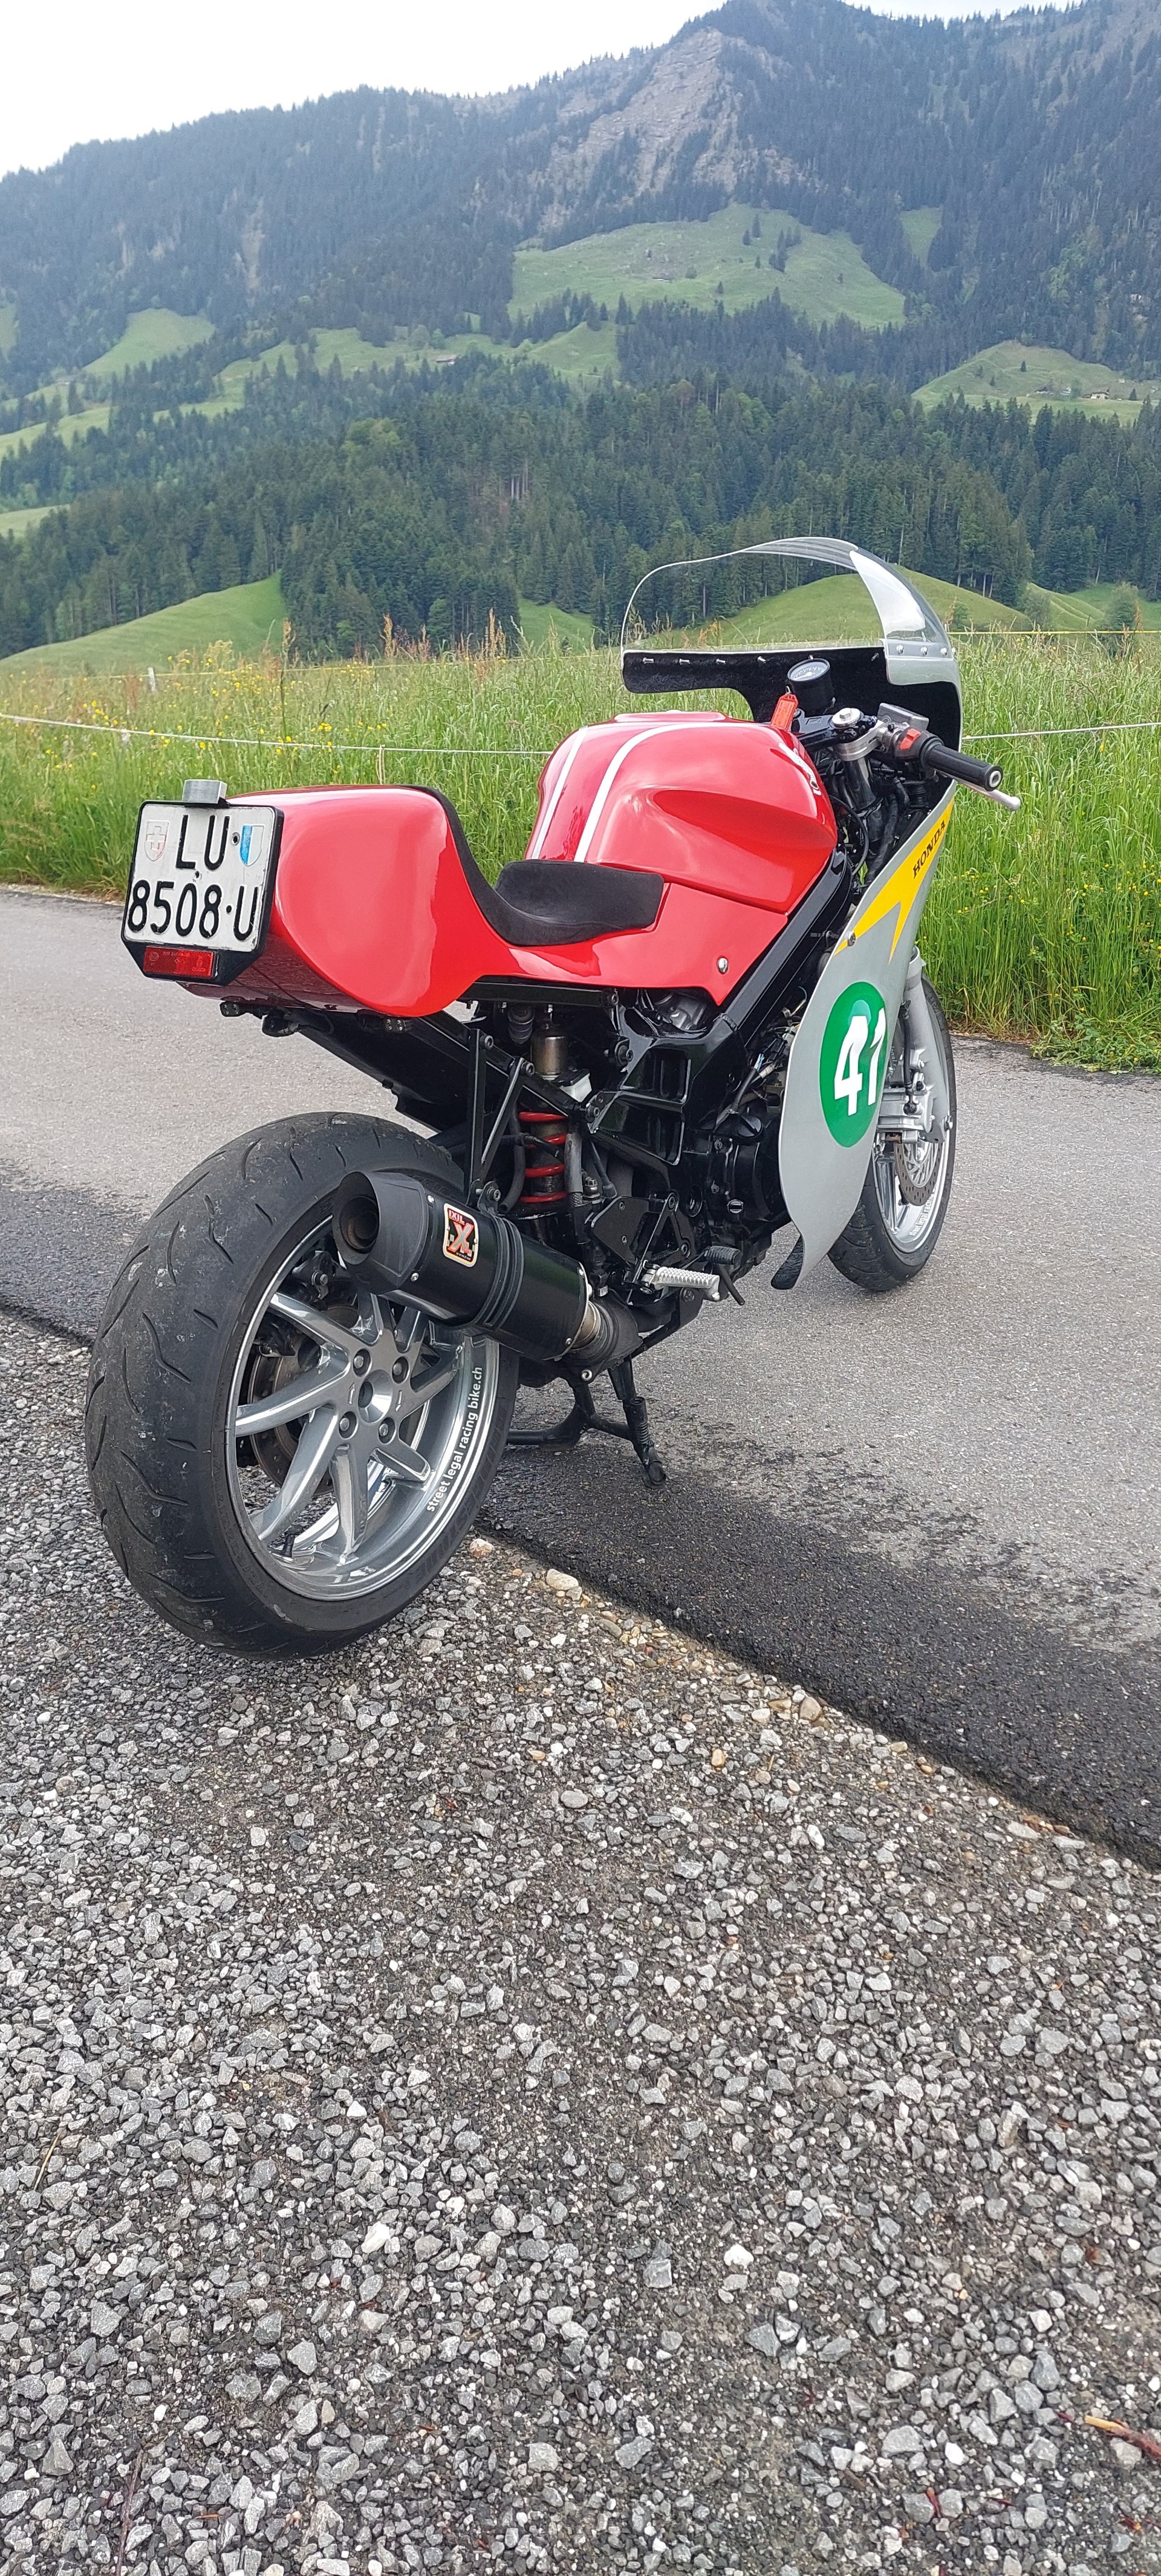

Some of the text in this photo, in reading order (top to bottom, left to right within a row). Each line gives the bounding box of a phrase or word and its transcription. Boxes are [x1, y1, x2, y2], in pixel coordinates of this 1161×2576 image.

[175, 815, 230, 871] LU
[912, 819, 946, 879] HONDA
[834, 1006, 886, 1116] 41
[448, 1209, 466, 1225] IXIL
[426, 1367, 483, 1512] street legal racing bike.ch
